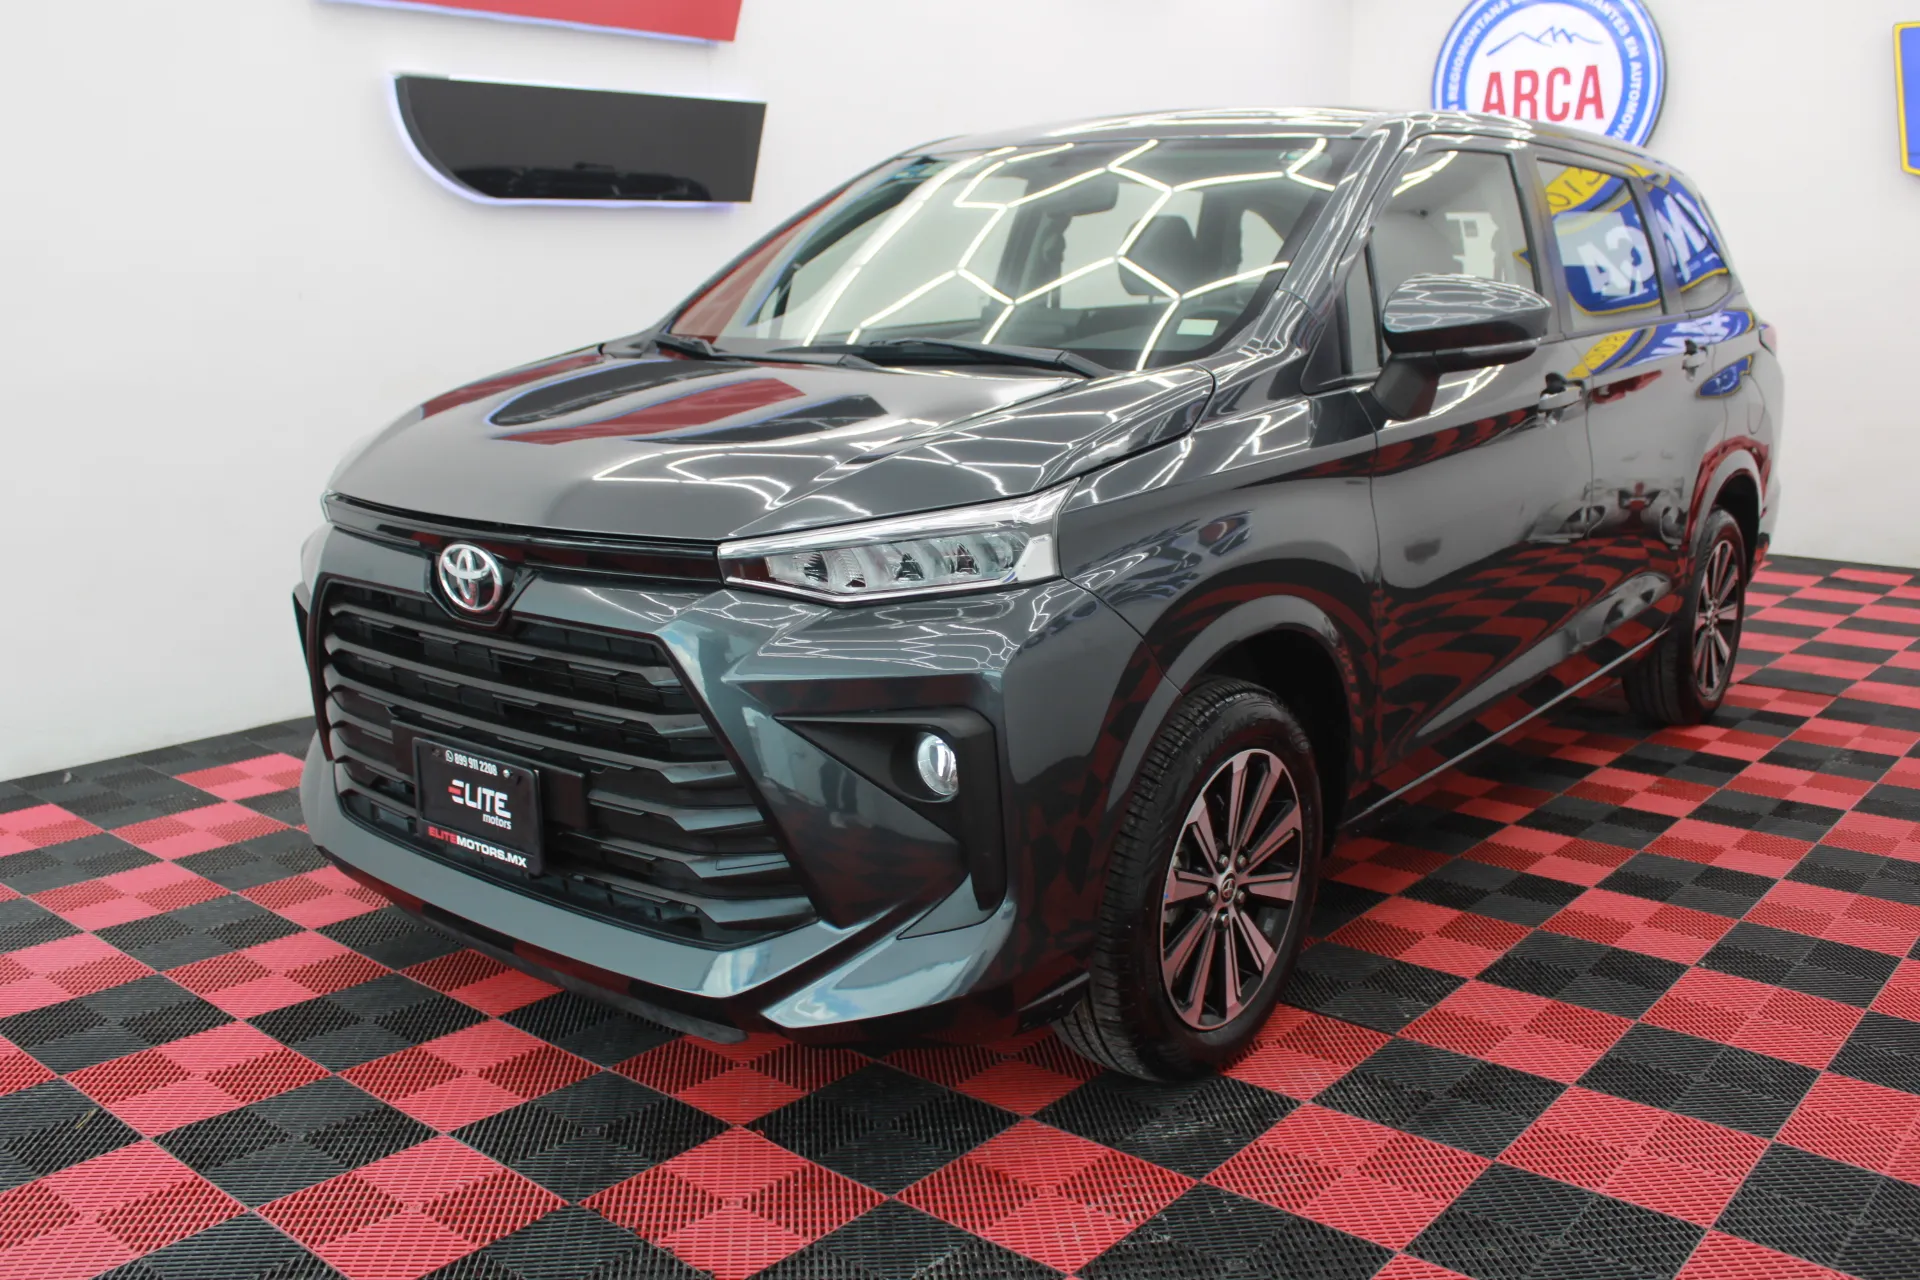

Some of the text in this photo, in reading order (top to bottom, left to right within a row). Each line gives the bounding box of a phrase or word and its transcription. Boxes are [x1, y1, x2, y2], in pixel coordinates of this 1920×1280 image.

[1448, 0, 1510, 102] REGIOMONTANA
[1623, 35, 1641, 59] EN
[1481, 64, 1605, 122] ARCA
[454, 752, 468, 767] 899
[448, 779, 512, 819] ELITE
[482, 813, 512, 830] motors
[427, 826, 528, 868] ELITEMOTORS.MX
